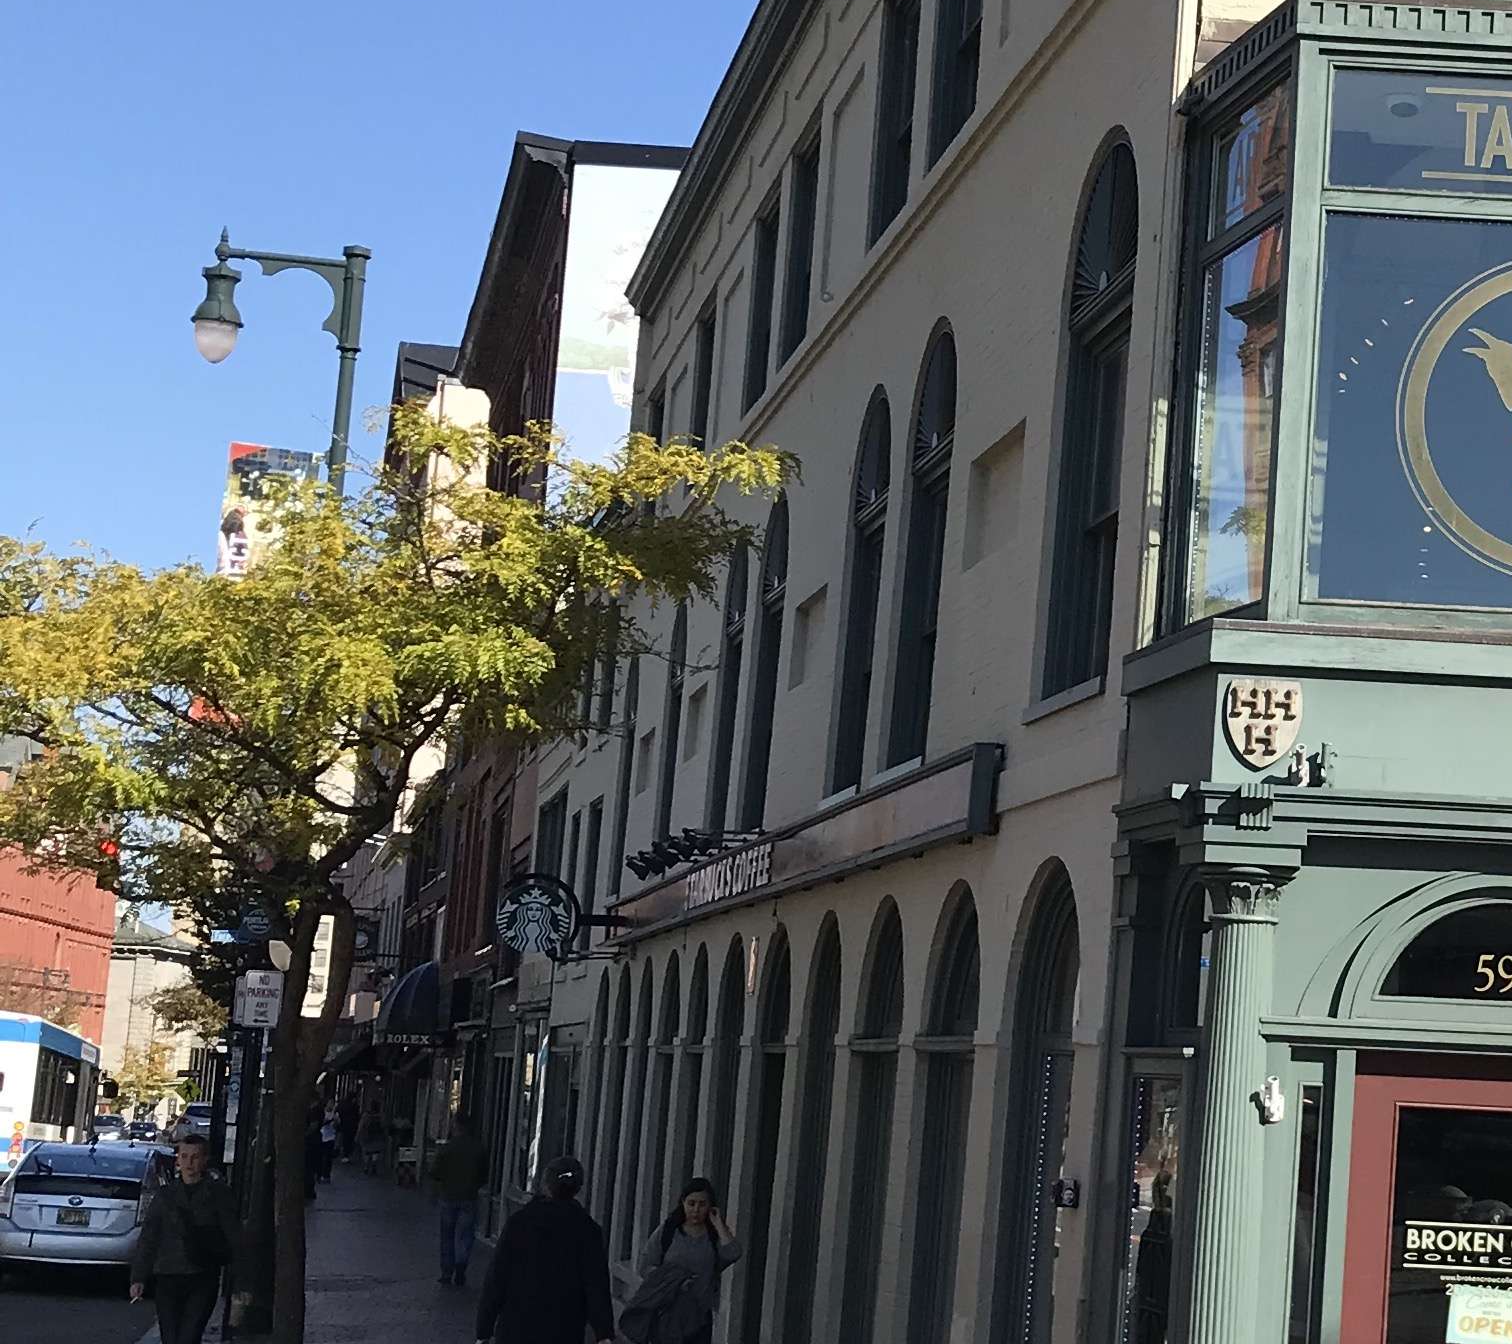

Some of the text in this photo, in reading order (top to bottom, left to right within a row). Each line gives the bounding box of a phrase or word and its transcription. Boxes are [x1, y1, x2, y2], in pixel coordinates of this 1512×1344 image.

[732, 842, 772, 896] COFFEE
[259, 975, 271, 985] NO
[247, 987, 280, 1000] PARKING
[255, 1001, 268, 1009] ANY
[386, 1034, 430, 1044] ROLEX
[1406, 1228, 1504, 1253] BROKEN
